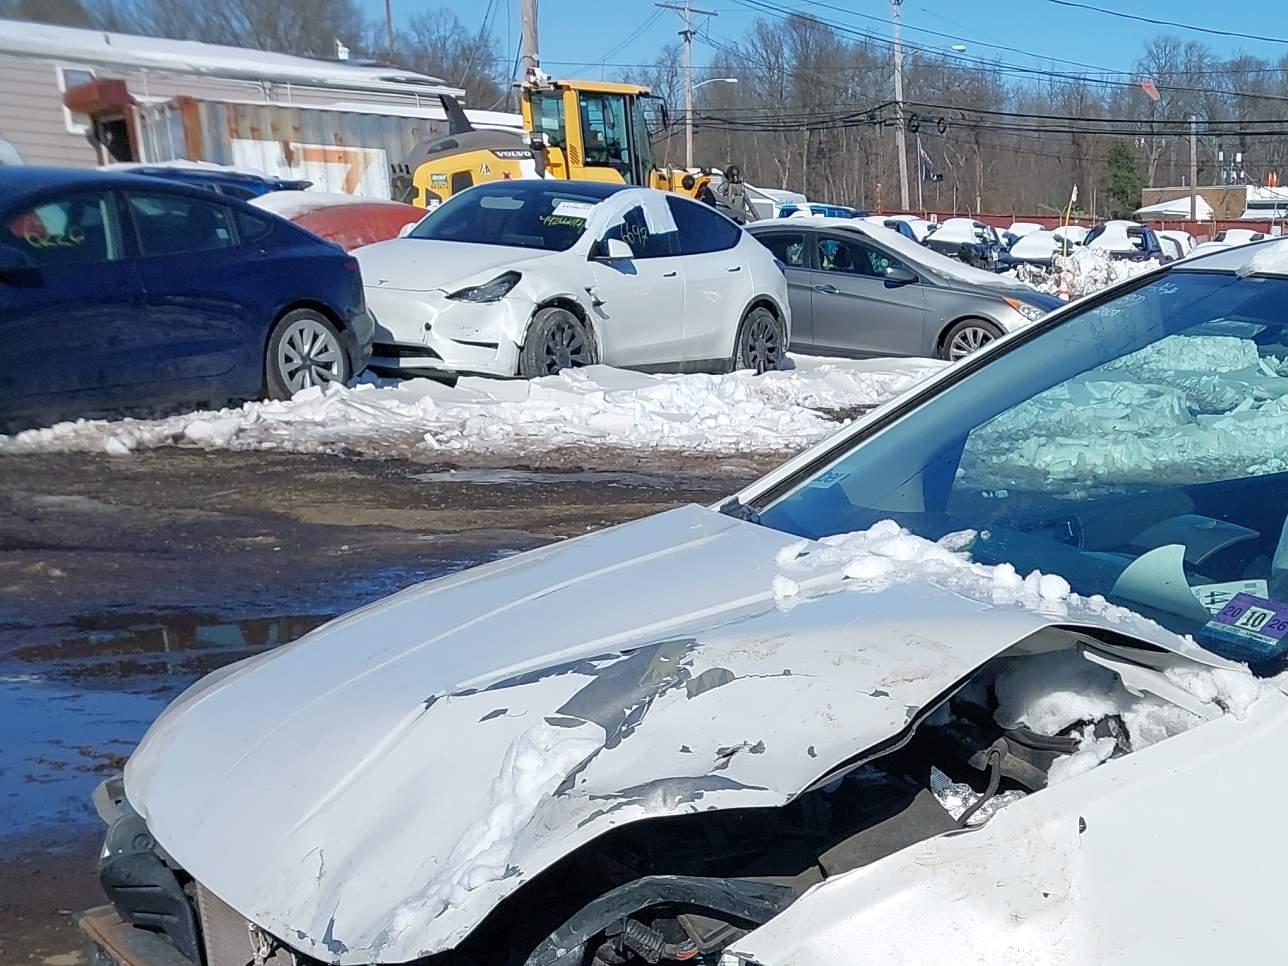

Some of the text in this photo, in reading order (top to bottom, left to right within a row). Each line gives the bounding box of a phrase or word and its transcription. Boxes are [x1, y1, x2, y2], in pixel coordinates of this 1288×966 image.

[495, 150, 532, 158] VOLVO
[1223, 606, 1288, 632] 20 10 26
